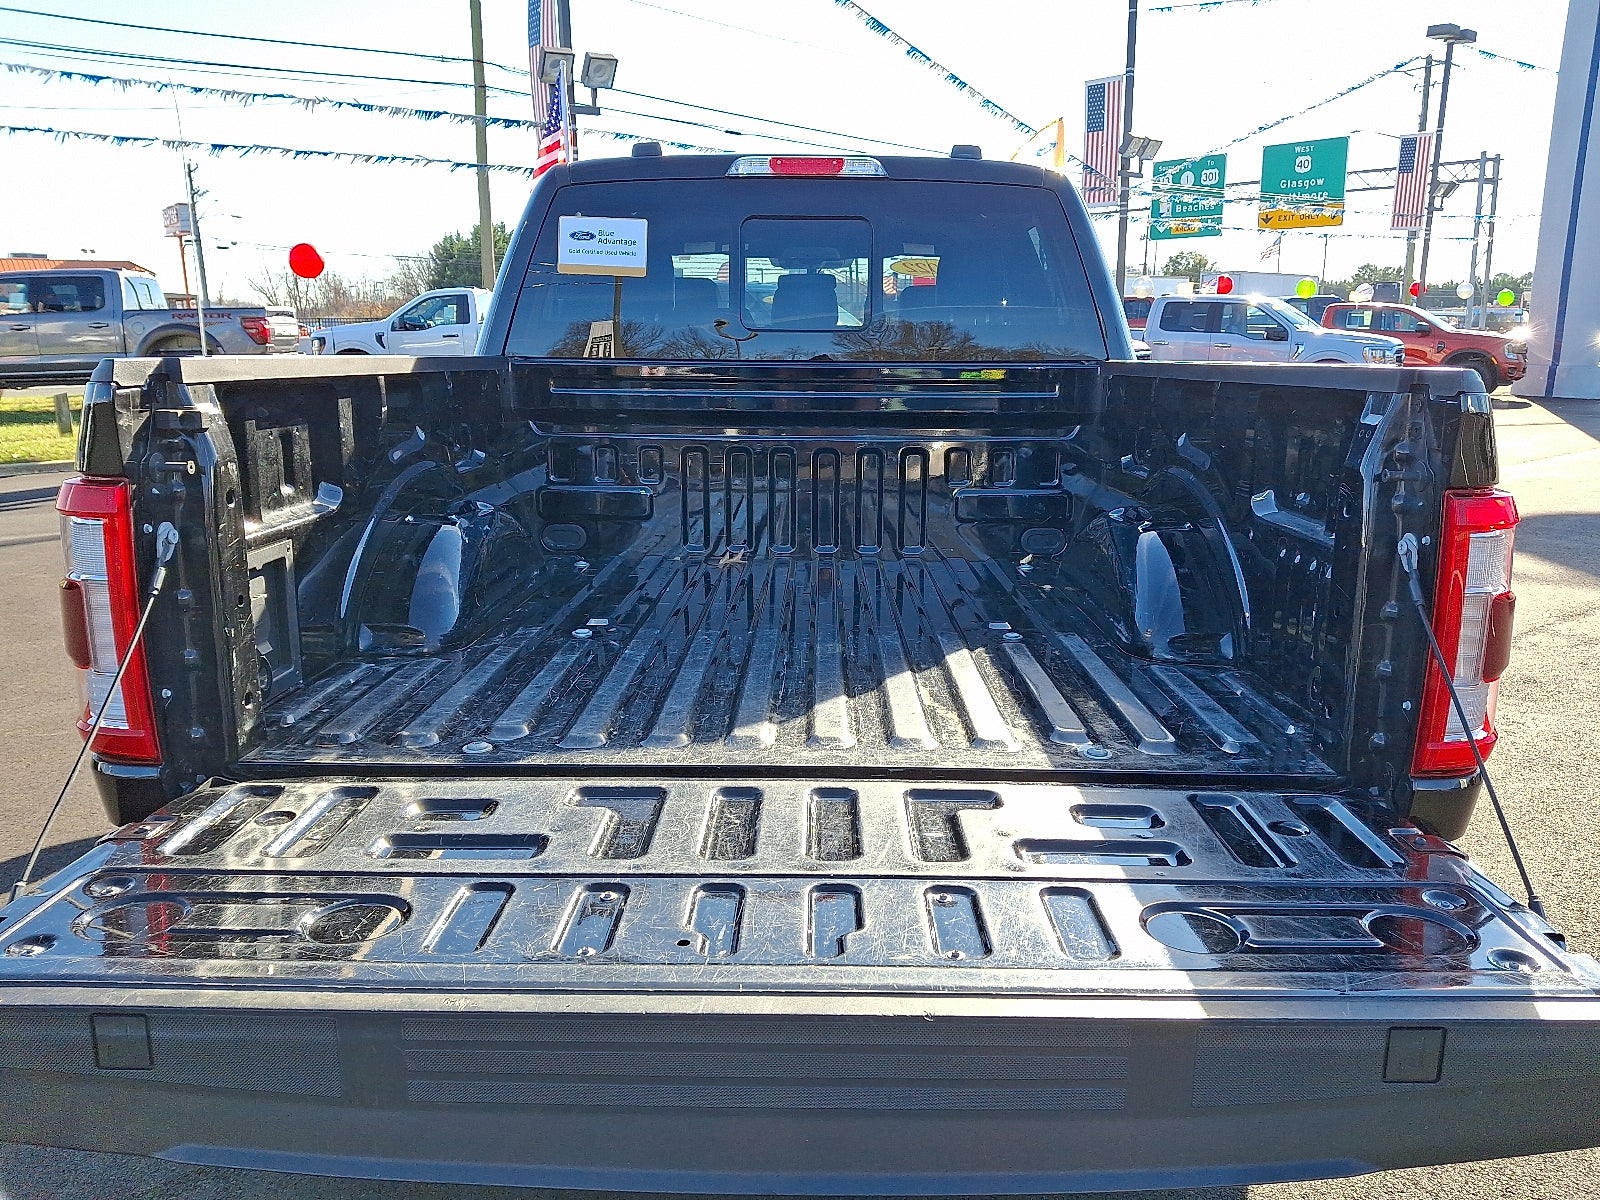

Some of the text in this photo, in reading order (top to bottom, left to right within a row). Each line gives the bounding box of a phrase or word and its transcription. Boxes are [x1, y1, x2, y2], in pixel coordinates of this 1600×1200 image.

[1295, 145, 1315, 153] WEST
[1296, 159, 1310, 169] 40
[1202, 171, 1218, 182] 301
[1280, 178, 1325, 190] Glasgow
[1175, 202, 1216, 213] Beaches
[1277, 213, 1320, 222] EXIT ONLY
[598, 229, 615, 237] Blue
[597, 237, 637, 247] Advantage
